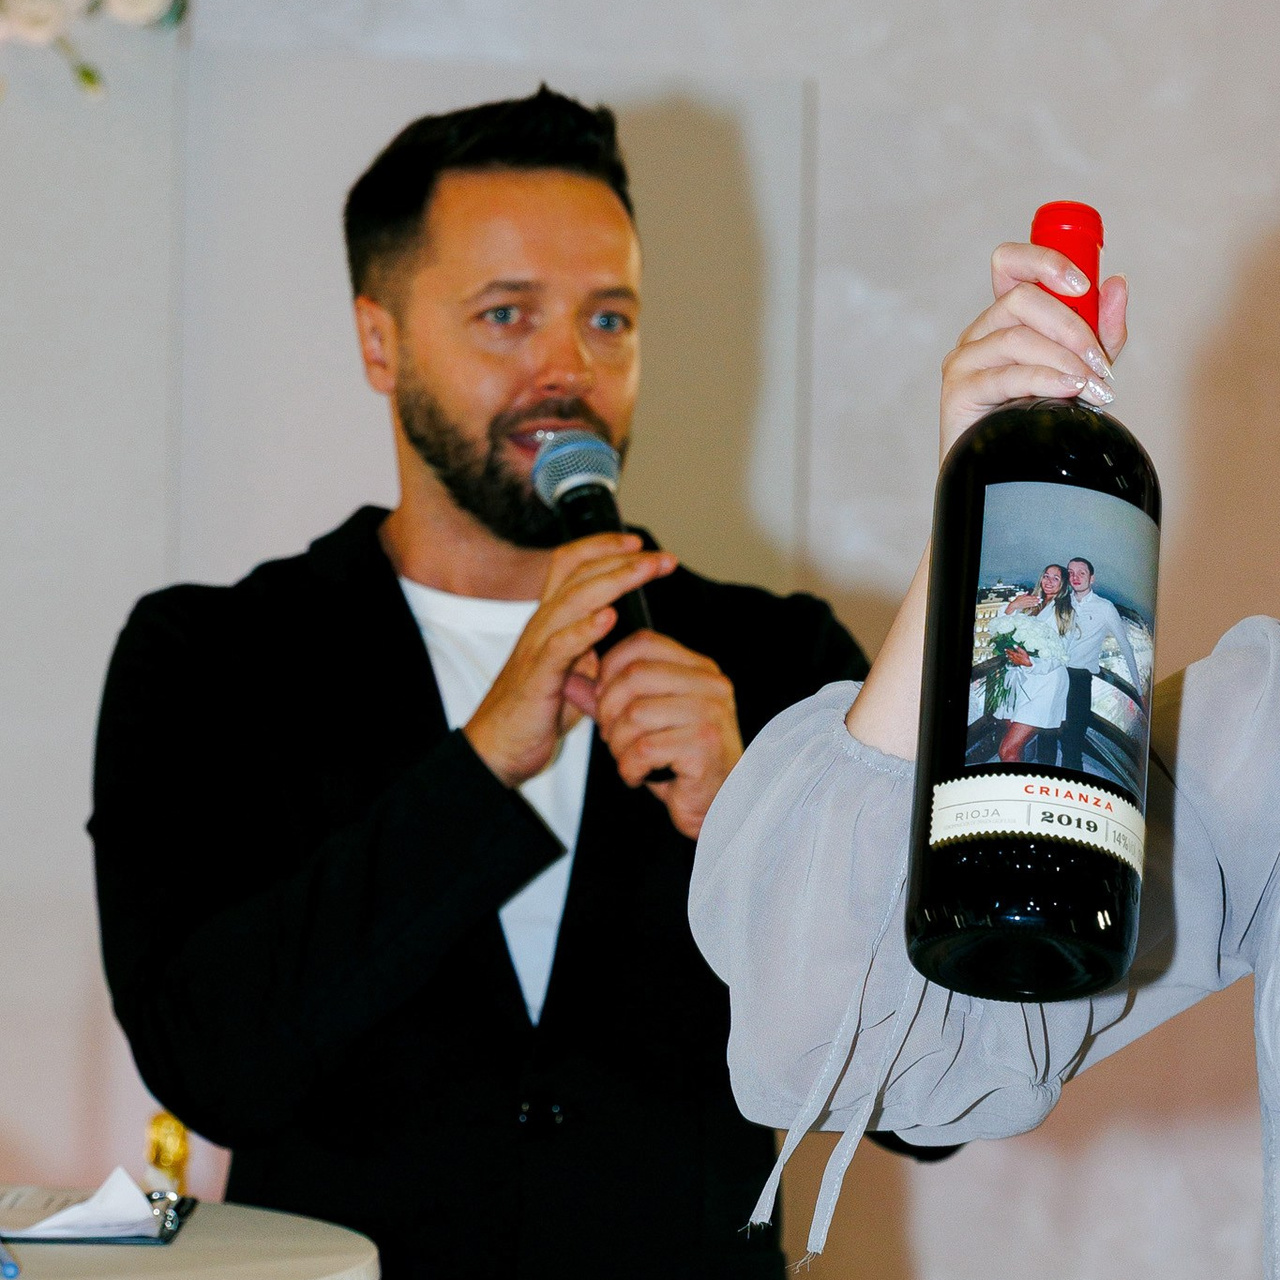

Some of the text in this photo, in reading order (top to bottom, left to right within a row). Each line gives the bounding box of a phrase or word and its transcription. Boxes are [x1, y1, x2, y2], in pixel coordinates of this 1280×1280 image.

[1024, 784, 1113, 813] CRIANZA
[955, 808, 1001, 822] RIOJA
[1040, 810, 1099, 834] 2019
